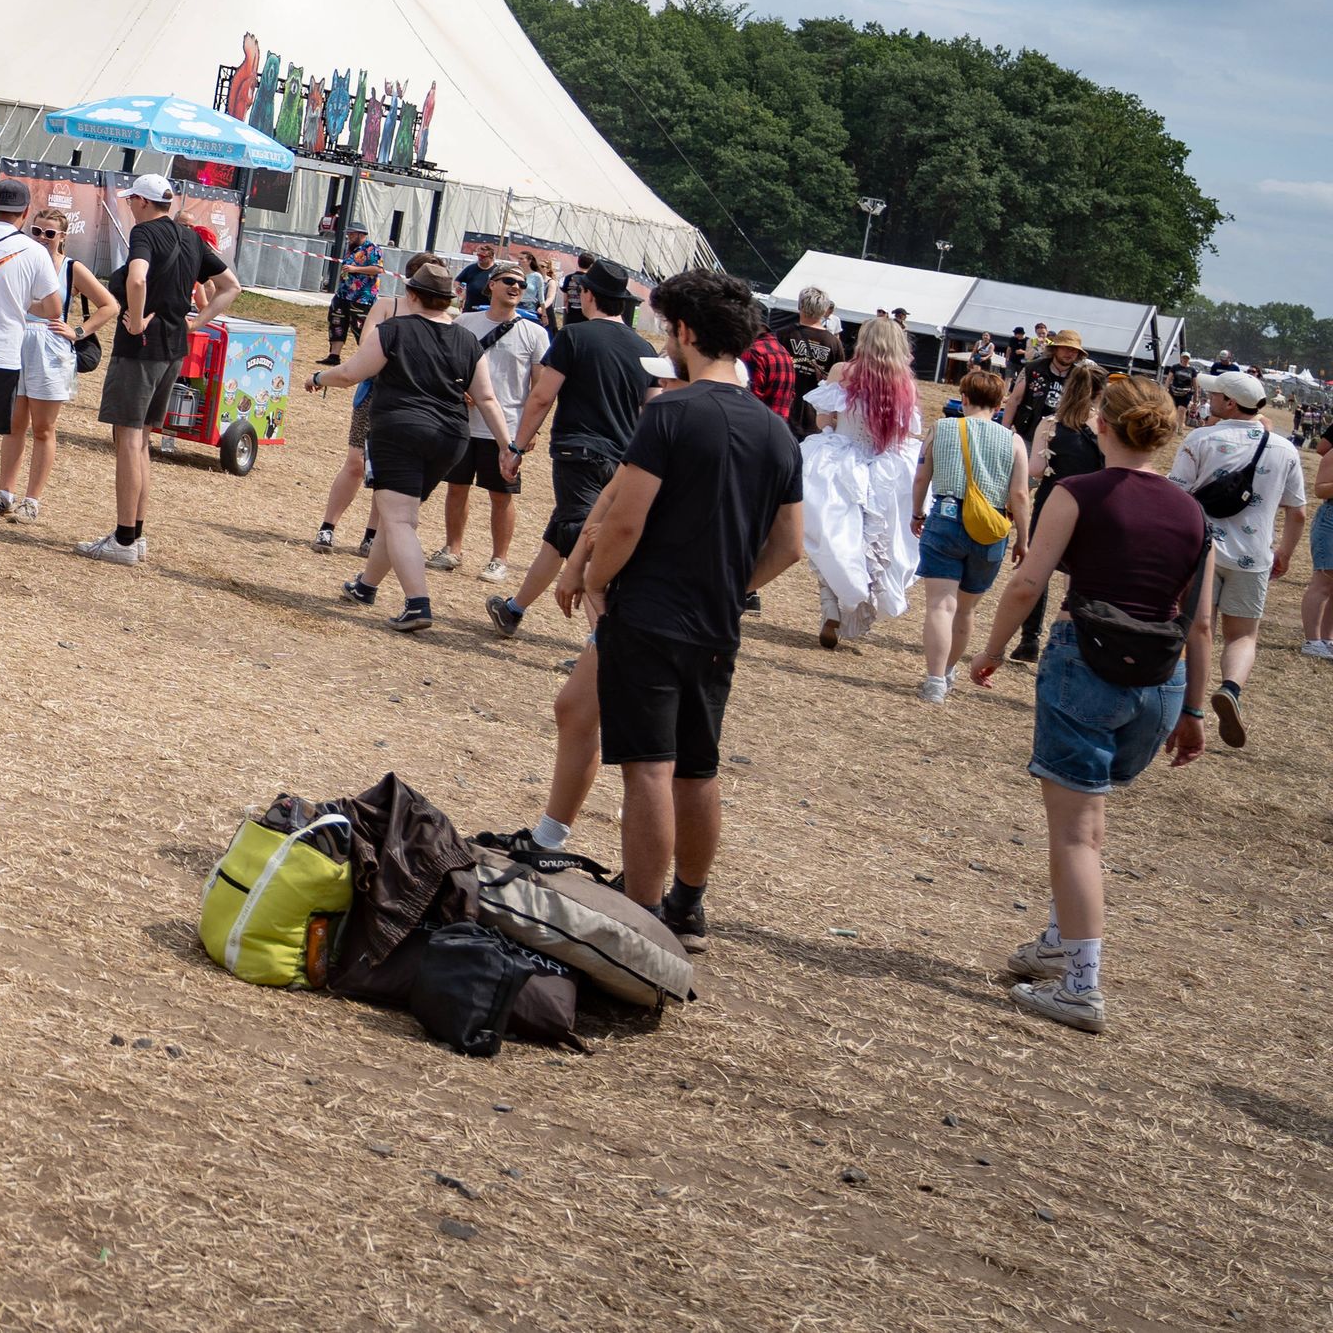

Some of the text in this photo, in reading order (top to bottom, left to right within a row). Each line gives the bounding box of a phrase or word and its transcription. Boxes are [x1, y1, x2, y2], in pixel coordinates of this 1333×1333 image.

[77, 122, 142, 139] BEN&JERRY'S
[160, 135, 234, 154] BEN&JERRY'S
[66, 220, 86, 235] EVER
[790, 338, 831, 362] VANS
